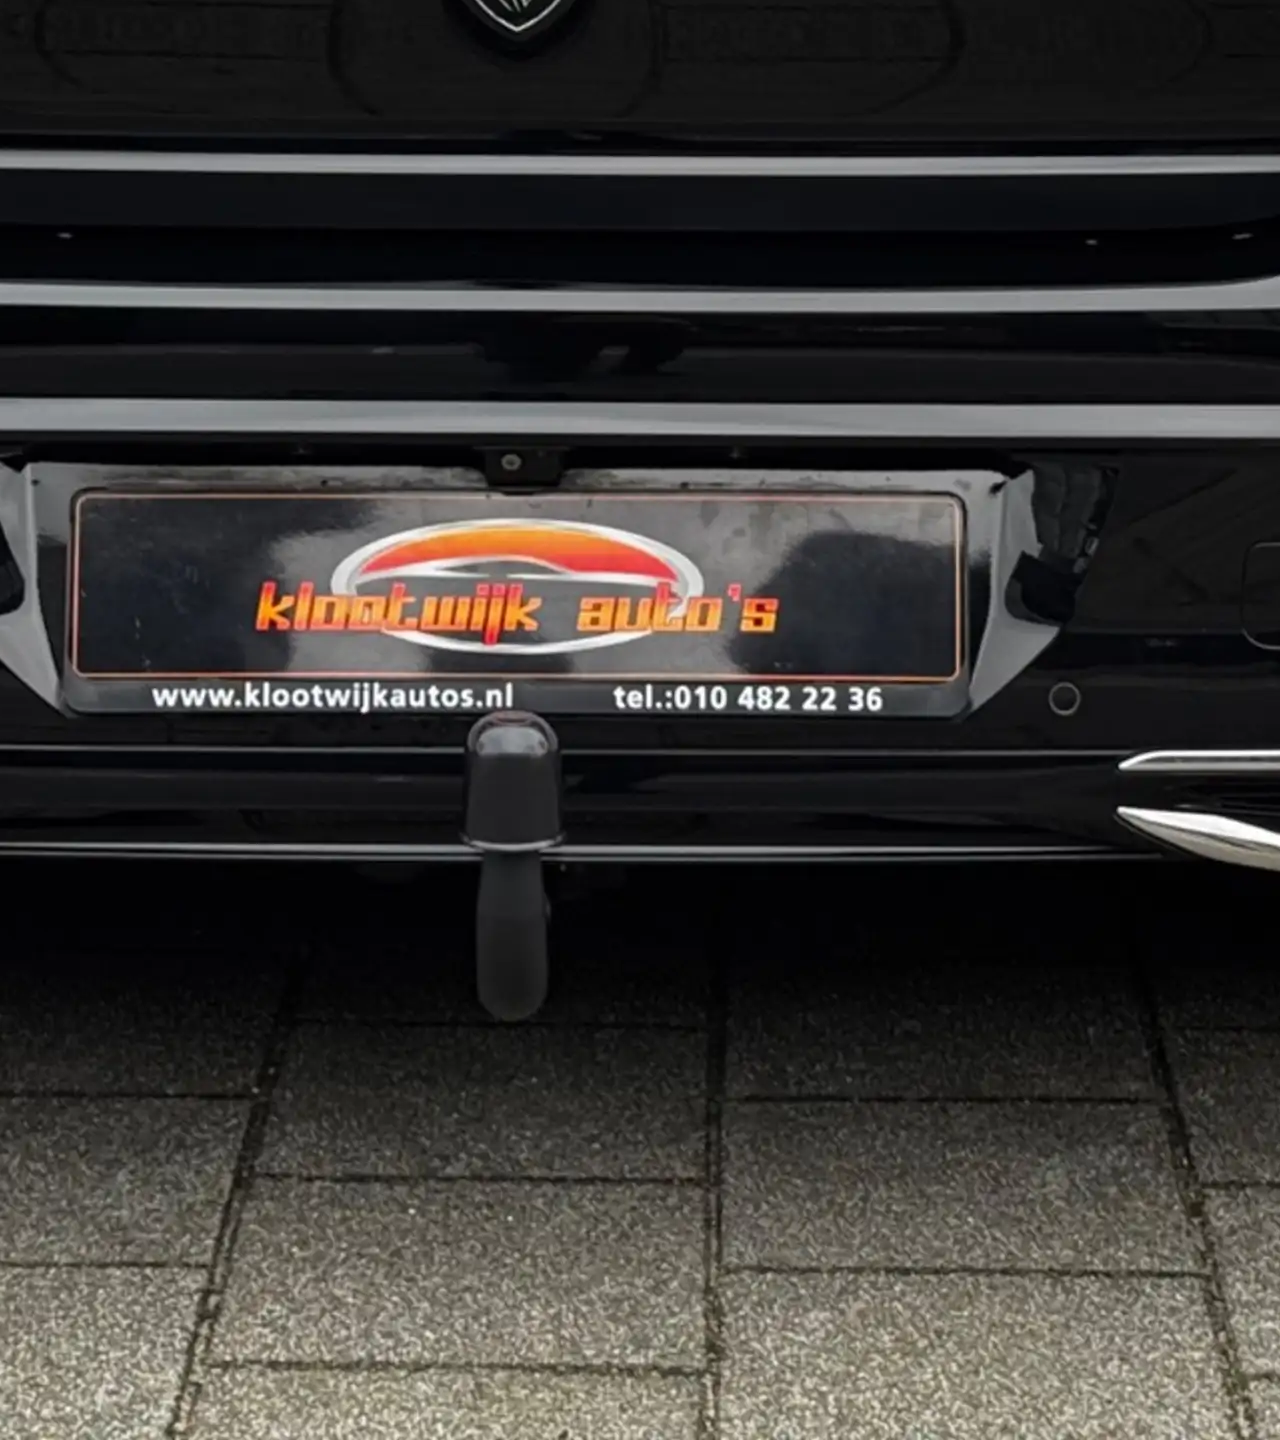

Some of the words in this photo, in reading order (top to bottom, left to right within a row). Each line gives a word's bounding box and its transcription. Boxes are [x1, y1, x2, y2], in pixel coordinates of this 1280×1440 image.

[255, 581, 541, 645] klootwijk
[576, 583, 779, 633] auto's
[152, 682, 513, 713] www.klootwijkautos.nl
[613, 684, 727, 709] tel.:010
[737, 686, 790, 710] 482
[802, 687, 836, 711] 22
[848, 687, 883, 711] 36
